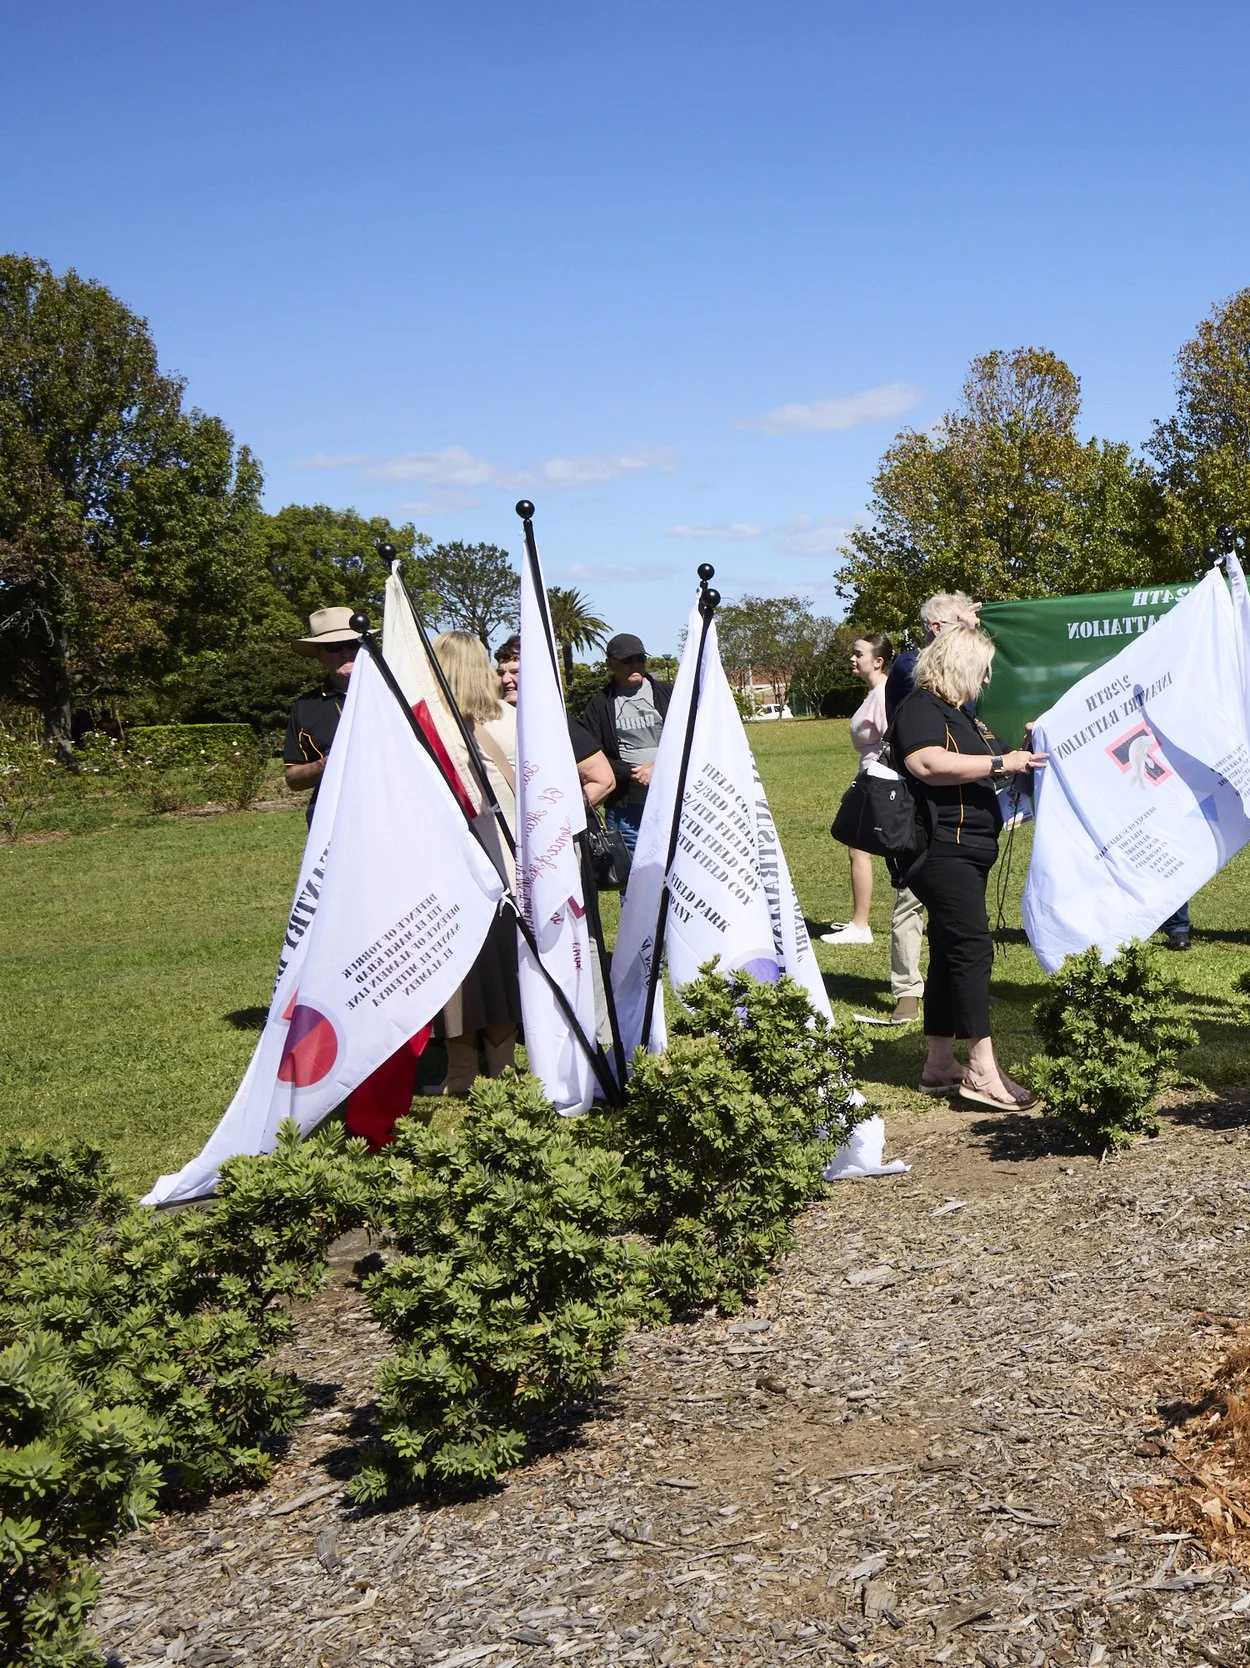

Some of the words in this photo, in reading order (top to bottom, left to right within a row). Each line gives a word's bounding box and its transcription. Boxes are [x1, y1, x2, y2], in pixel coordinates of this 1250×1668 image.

[692, 779, 728, 812] 2/3RD
[701, 763, 736, 796] FIELD
[682, 791, 717, 824] 2/4TH
[714, 820, 750, 857] FIELD
[692, 848, 729, 884] FIELD
[727, 879, 754, 907] COY
[701, 832, 738, 868] FIELD
[737, 866, 762, 893] COY
[693, 898, 731, 934] PARK
